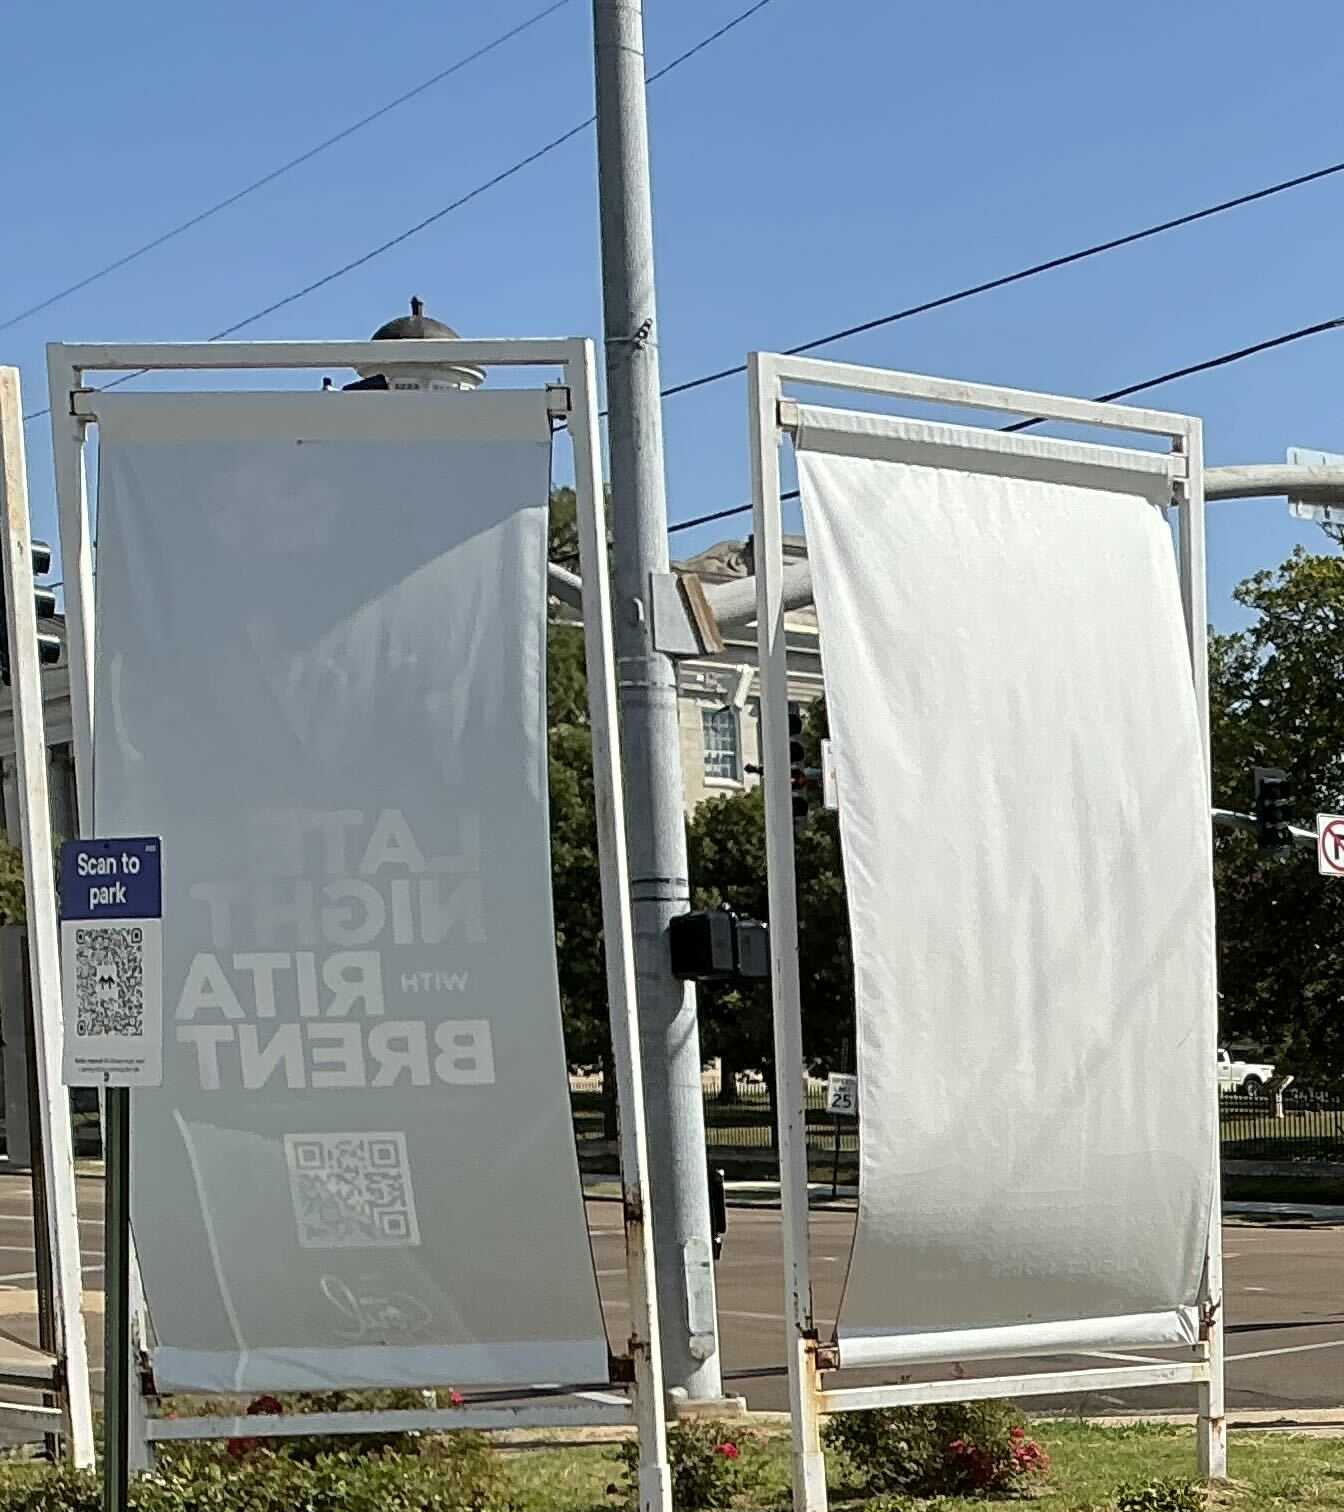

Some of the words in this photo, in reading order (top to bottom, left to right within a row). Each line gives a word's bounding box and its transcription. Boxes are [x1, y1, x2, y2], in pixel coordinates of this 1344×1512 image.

[77, 852, 117, 876] Scan
[121, 851, 141, 875] to
[89, 881, 127, 911] park
[832, 1093, 852, 1109] 25
